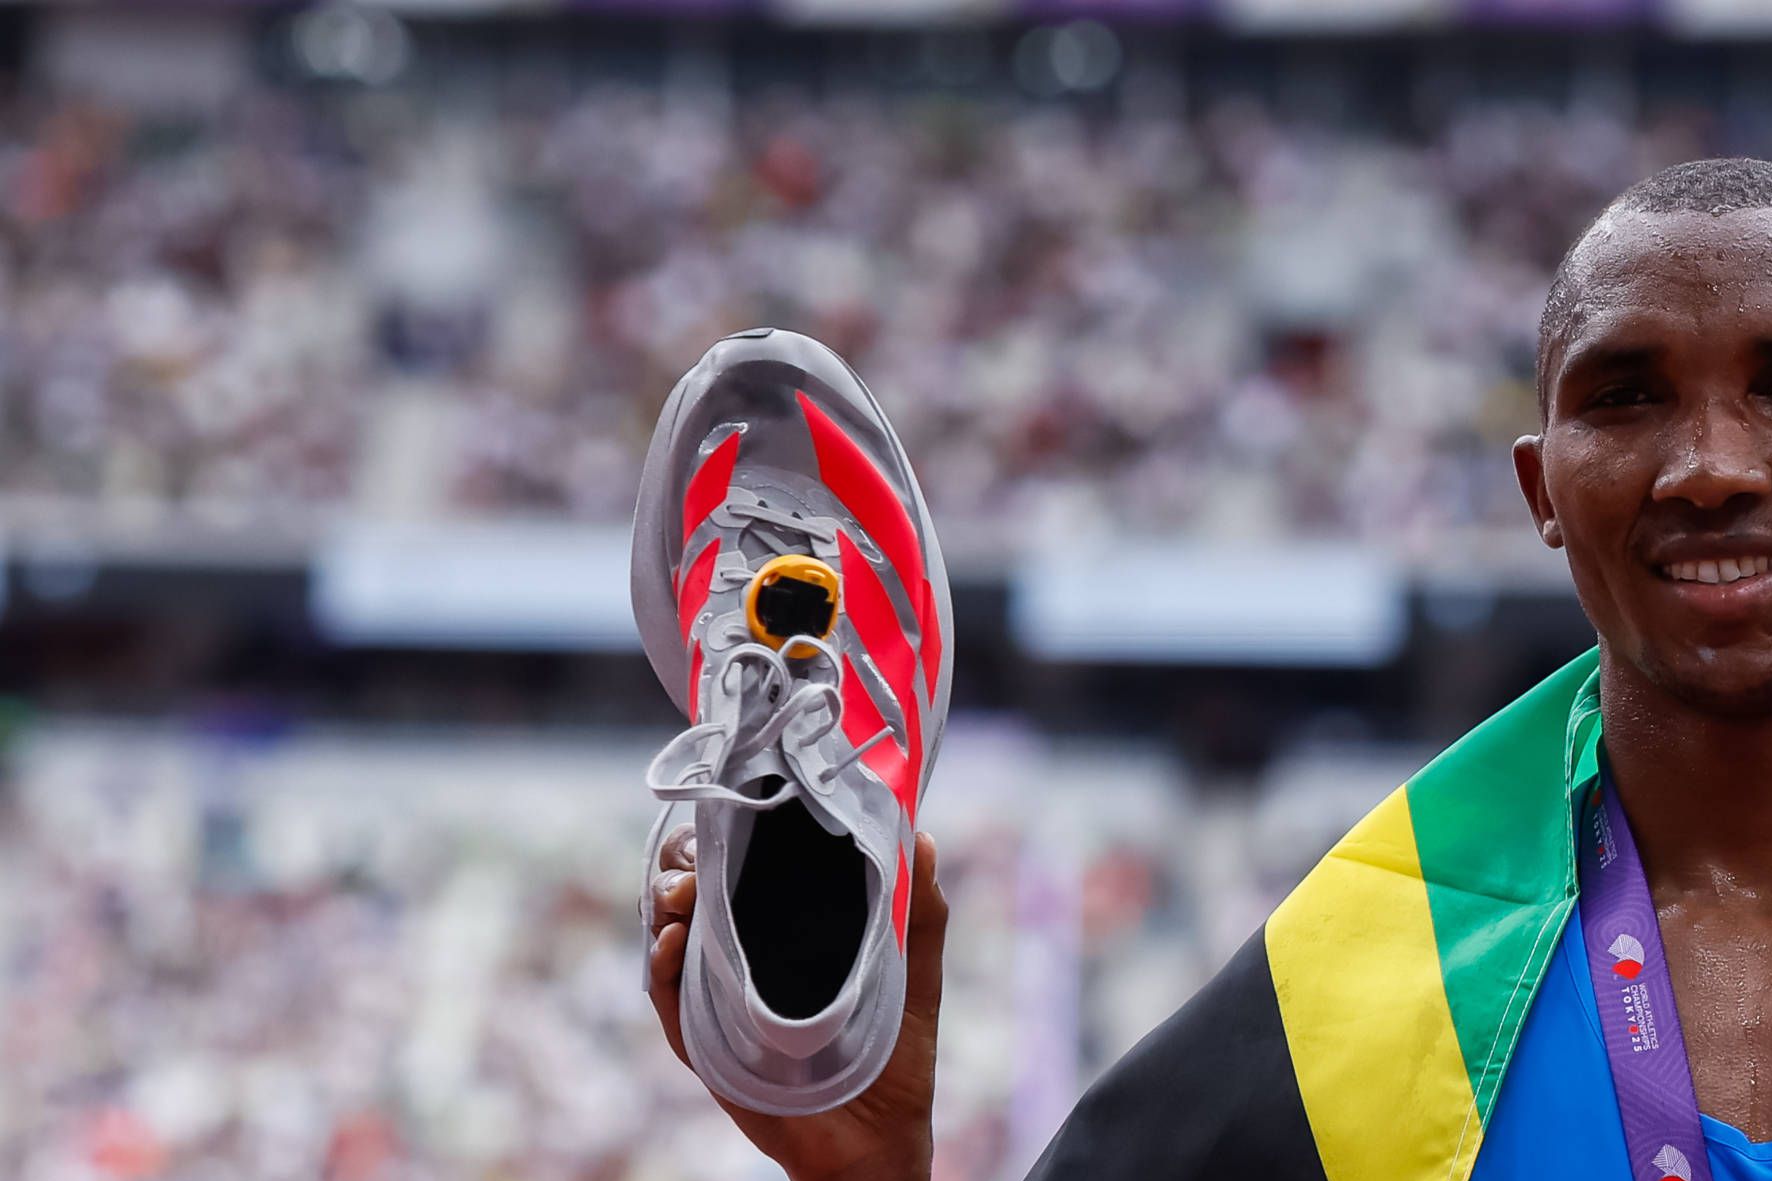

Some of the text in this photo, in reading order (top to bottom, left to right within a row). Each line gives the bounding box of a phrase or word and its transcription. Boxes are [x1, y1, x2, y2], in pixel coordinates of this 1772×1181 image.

[1631, 985, 1650, 1051] CHAMPIONSHIPS
[1638, 983, 1659, 1049] WORLD ATHLETICS
